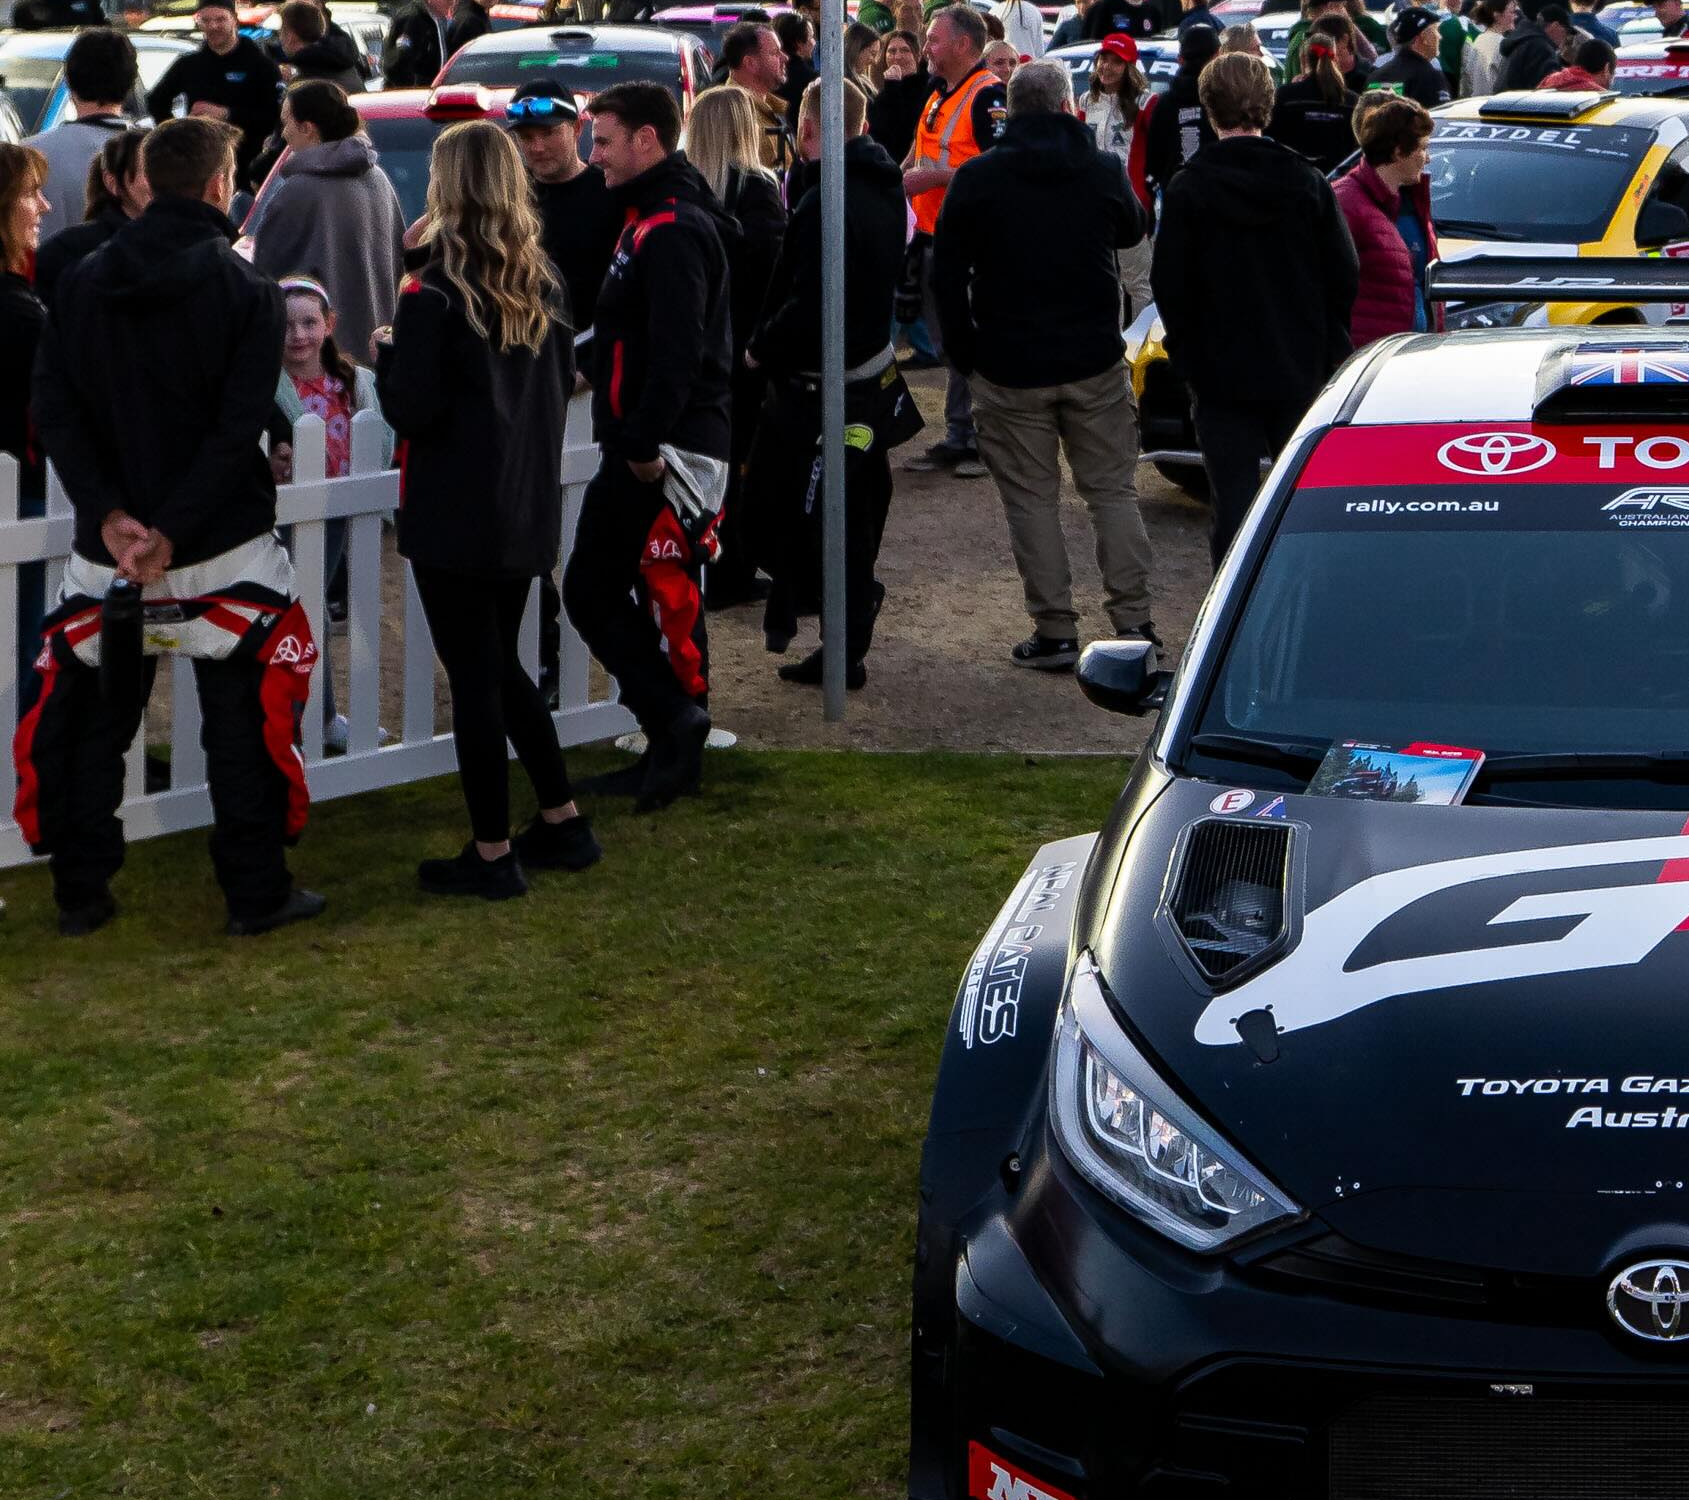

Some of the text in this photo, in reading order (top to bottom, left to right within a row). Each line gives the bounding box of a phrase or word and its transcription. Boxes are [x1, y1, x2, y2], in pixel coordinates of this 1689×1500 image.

[1437, 126, 1582, 145] TRYDEL
[1345, 499, 1500, 515] rally.com.au
[1221, 792, 1245, 811] E
[1456, 1077, 1610, 1097] TOYOTA
